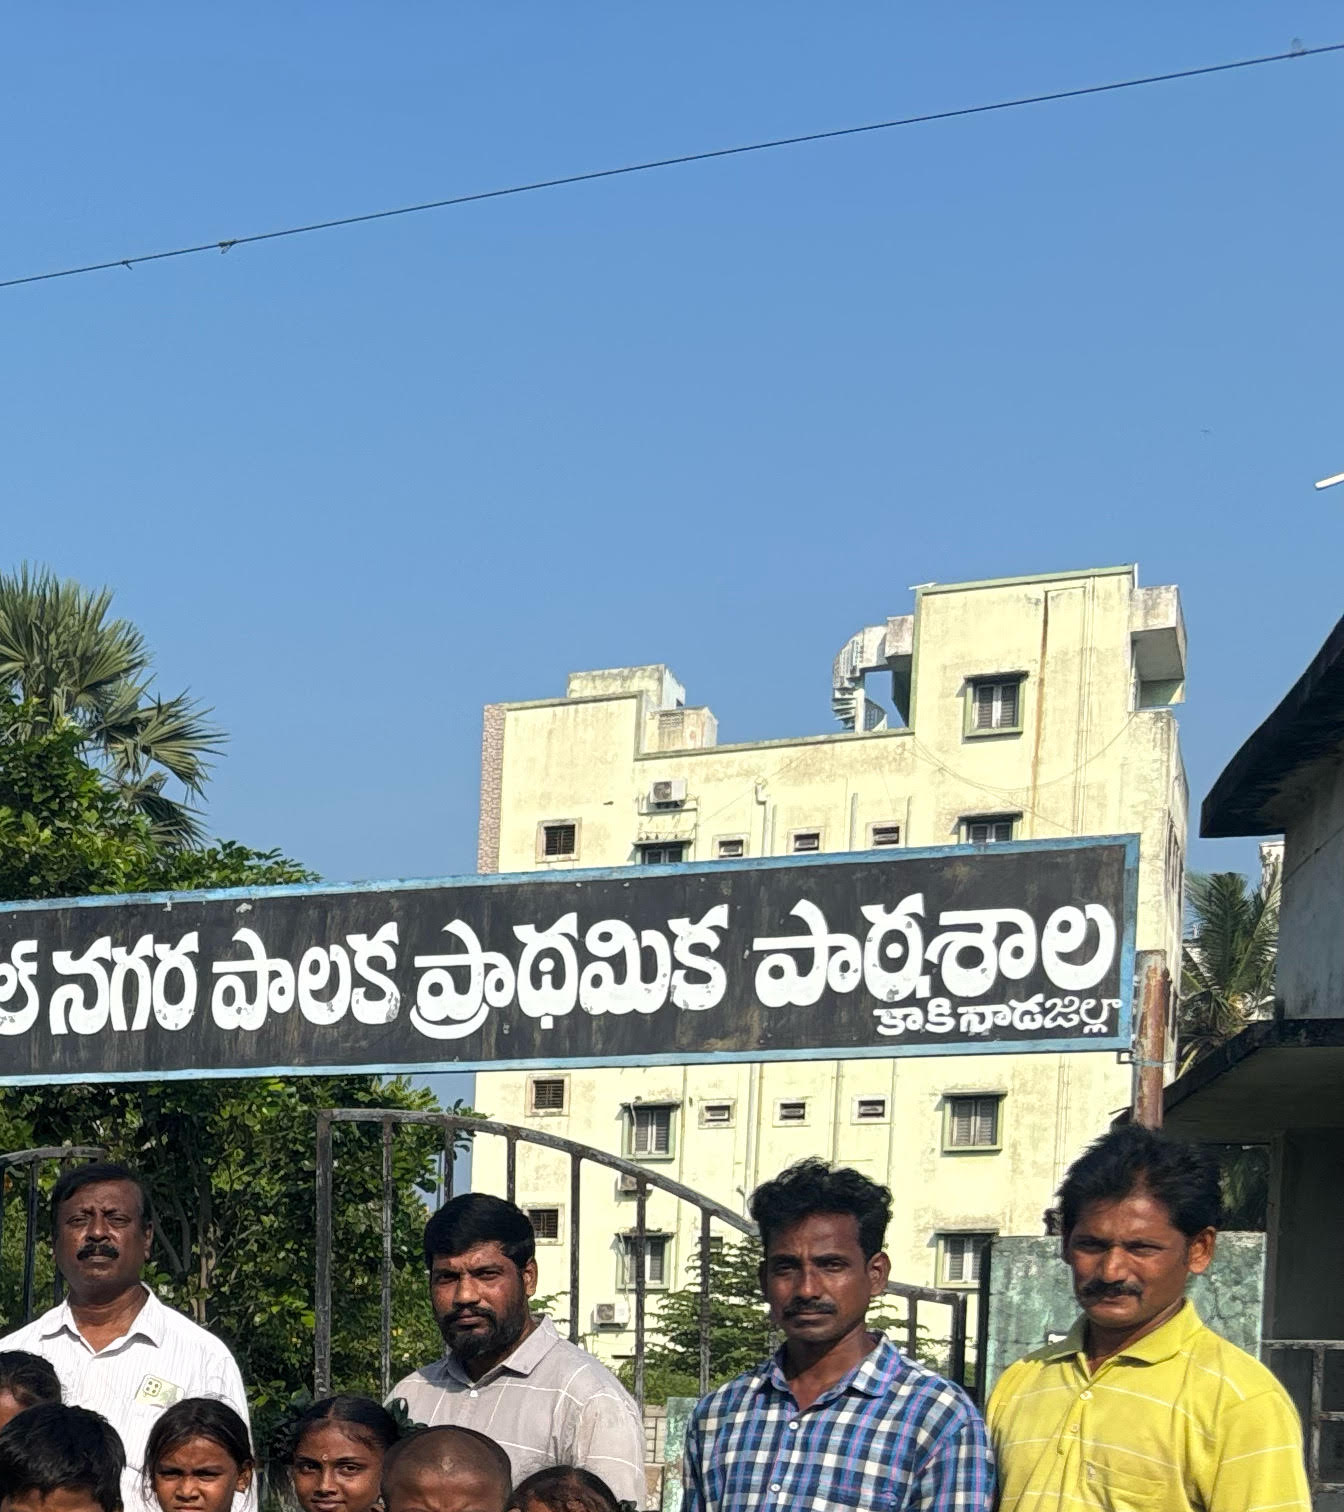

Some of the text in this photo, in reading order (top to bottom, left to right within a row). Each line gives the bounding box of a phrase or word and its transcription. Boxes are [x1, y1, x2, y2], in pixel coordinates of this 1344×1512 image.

[51, 931, 199, 1036] నగర
[212, 921, 400, 1031] పాలక
[410, 904, 729, 1040] ప్రాథమిక
[753, 892, 1115, 1009] పాఠశాల
